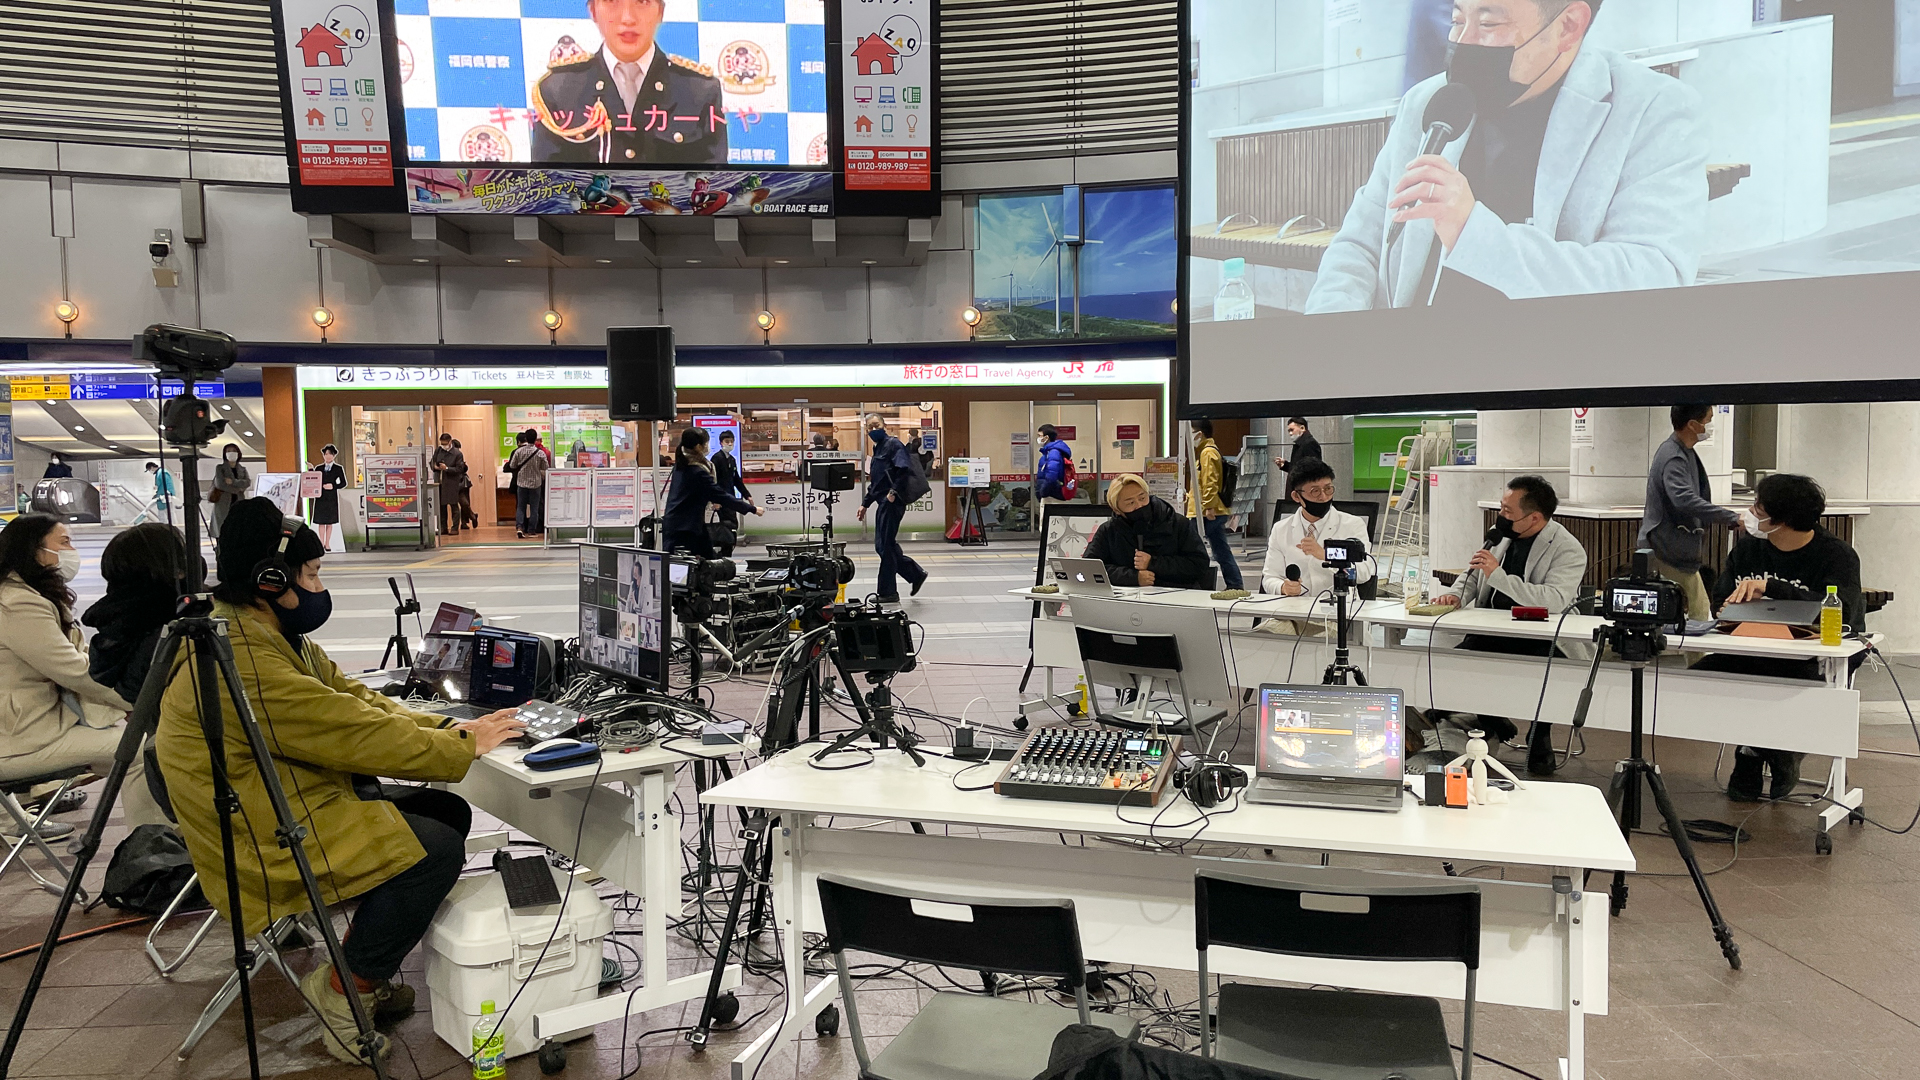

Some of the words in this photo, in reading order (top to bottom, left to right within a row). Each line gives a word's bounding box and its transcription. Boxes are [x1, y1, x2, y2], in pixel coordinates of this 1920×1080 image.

[329, 18, 365, 42] ZAQ
[884, 28, 916, 51] ZAQ
[312, 156, 368, 165] 0120-989-989
[857, 162, 909, 171] 0120-989-989
[472, 173, 552, 197] 毎日がドキドキ。
[763, 204, 785, 213] BOAT
[785, 204, 806, 213] RACE
[903, 364, 978, 379] 旅行の窓口
[983, 368, 1013, 378] Travel
[1016, 368, 1054, 379] Agency
[1062, 361, 1084, 374] JR
[1094, 360, 1115, 374] JTB
[472, 370, 507, 380] Tickets
